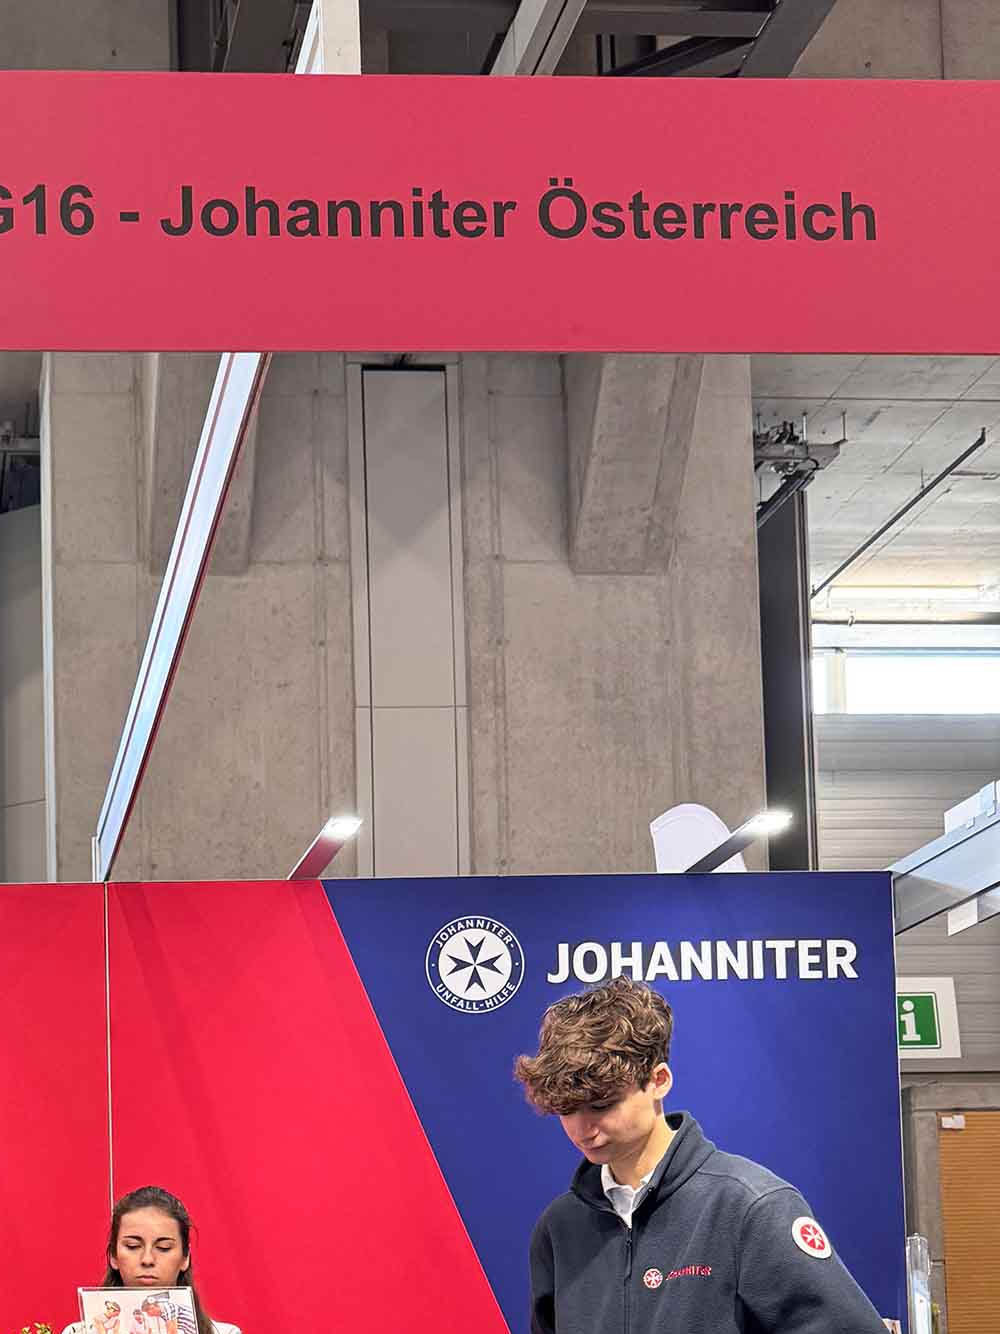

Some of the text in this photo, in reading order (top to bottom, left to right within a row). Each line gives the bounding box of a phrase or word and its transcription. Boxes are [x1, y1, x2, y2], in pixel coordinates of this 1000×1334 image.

[119, 211, 140, 223] -
[160, 185, 517, 238] Johanniter
[538, 177, 878, 241] Österreich
[546, 938, 860, 984] JOHANNITER
[436, 982, 516, 1011] UNFALL-HILFE
